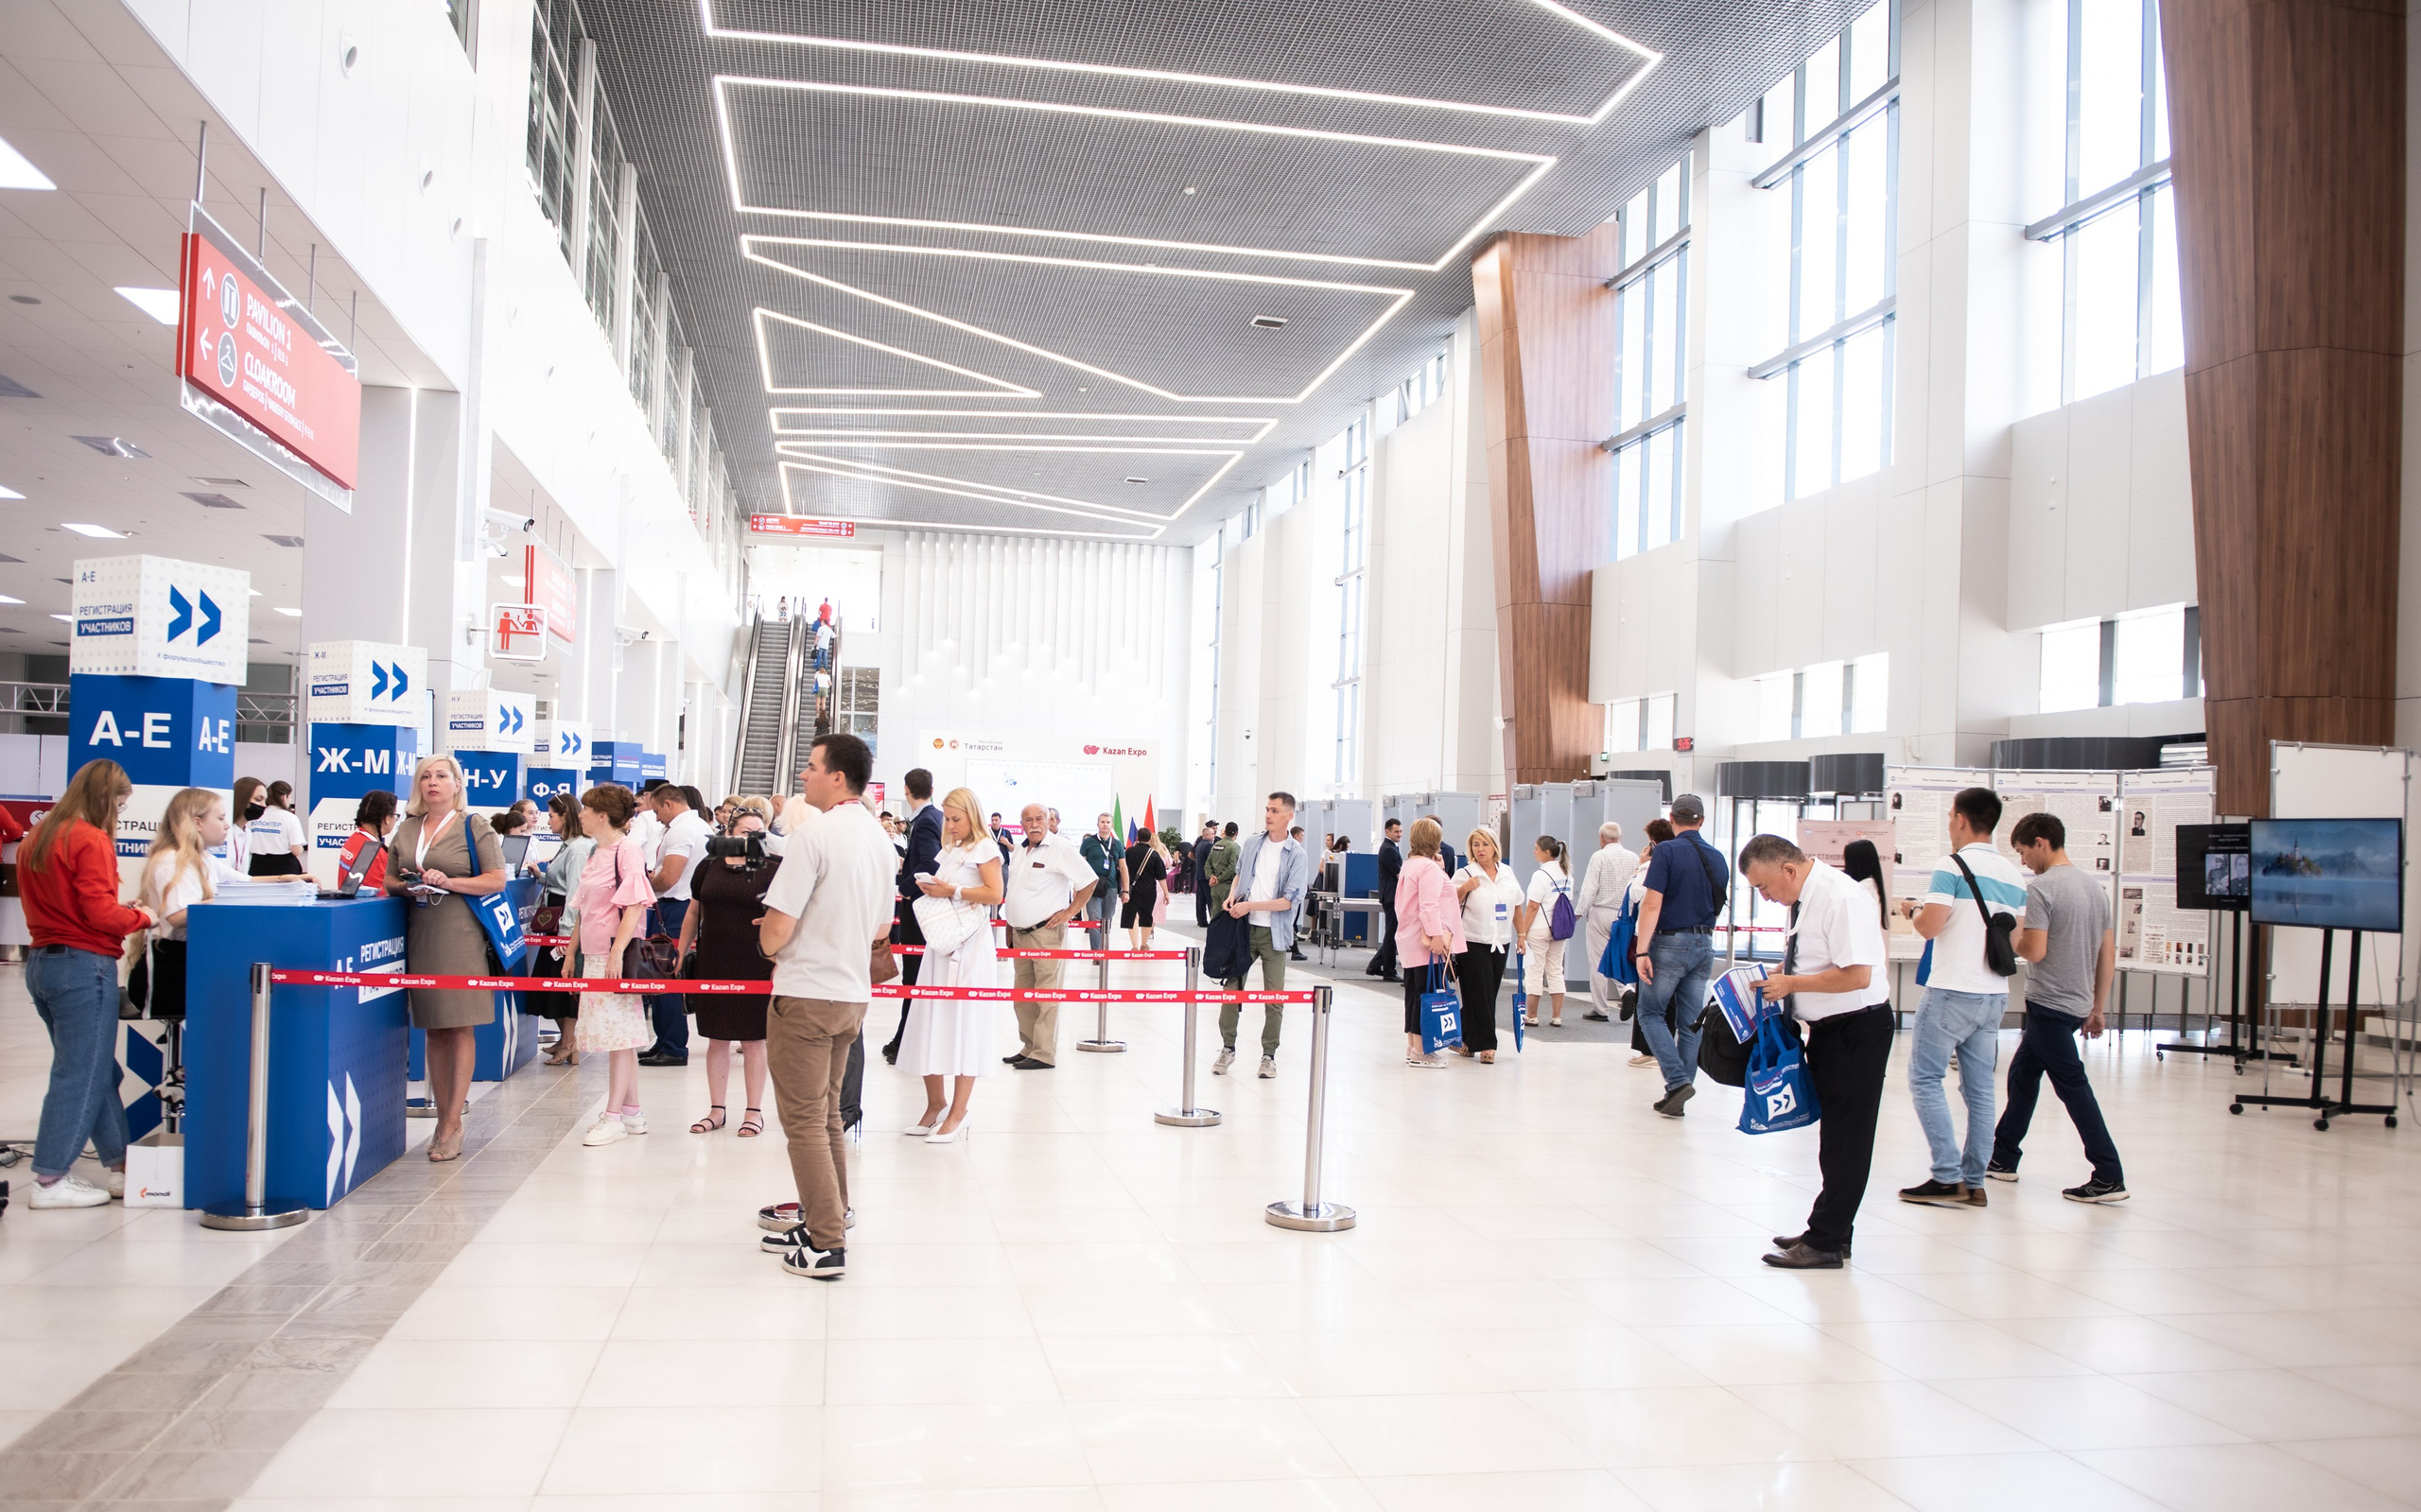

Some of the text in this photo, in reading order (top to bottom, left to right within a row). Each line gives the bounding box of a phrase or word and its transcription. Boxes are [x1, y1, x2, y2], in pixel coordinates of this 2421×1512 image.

[247, 292, 291, 352] PAVILION 1
[244, 351, 296, 409] CLOAKROOM
[81, 571, 96, 582] А-Е
[79, 603, 132, 616] РЕГИСТРАЦИЯ
[80, 620, 131, 634] УЧАСТНИКОВ
[162, 652, 226, 667] форумсообщество
[313, 673, 348, 682] РЕГИСТРАЦИЯ
[314, 686, 347, 695] УЧАСТНИКОВ
[89, 710, 172, 749] А-Е
[199, 716, 230, 754] А-Е
[965, 742, 1002, 751] Татарстан
[1103, 746, 1147, 757] Kazan Expo
[317, 747, 390, 774] Ж-М
[396, 751, 416, 776] Ж-М
[463, 768, 507, 789] Н-У
[532, 782, 570, 798] Ф-Я
[360, 936, 404, 963] РЕГИСТРАЦИЯ
[345, 976, 361, 984] Expo
[881, 986, 897, 995] Expo
